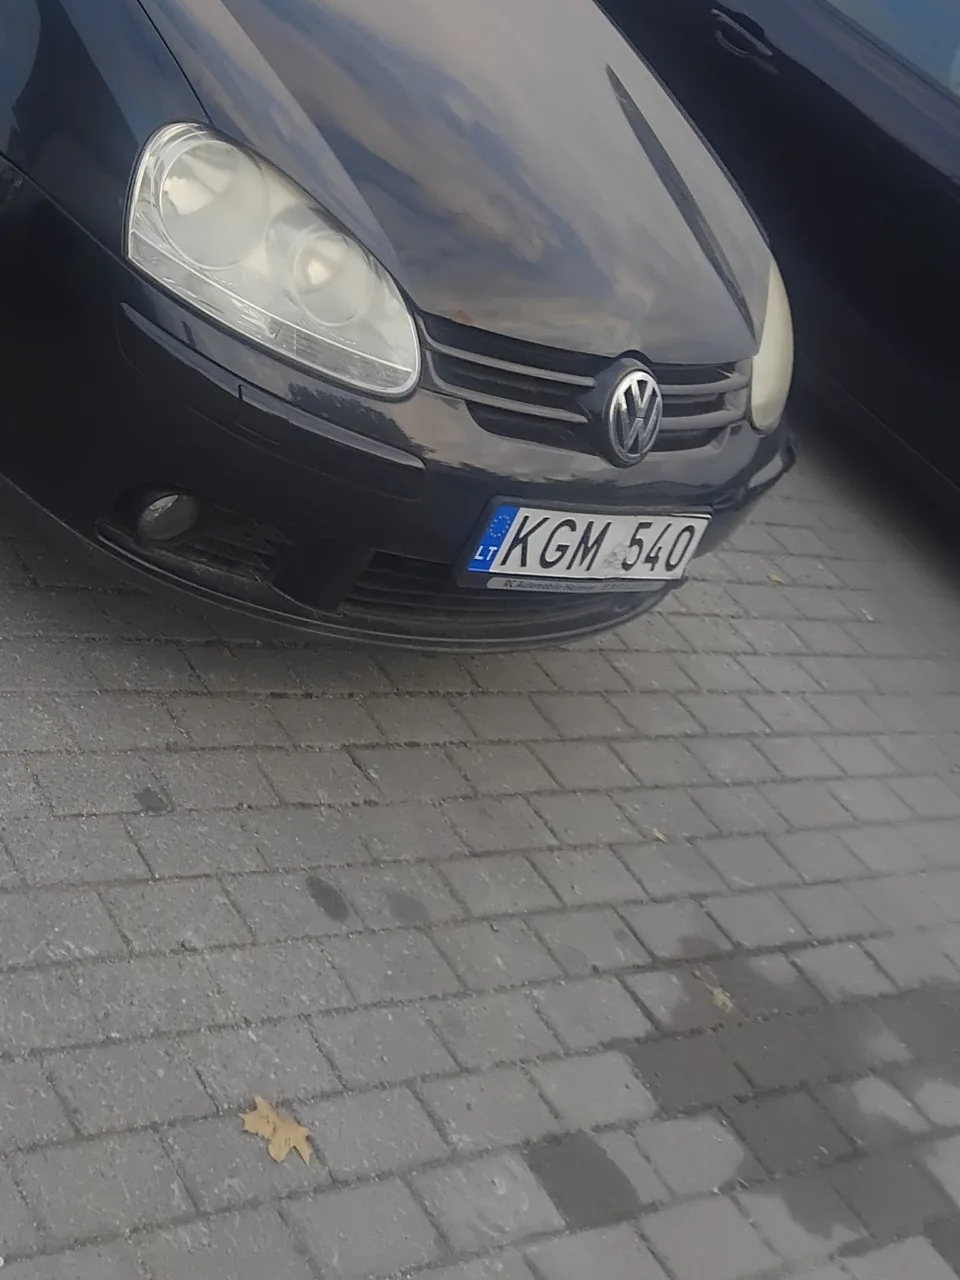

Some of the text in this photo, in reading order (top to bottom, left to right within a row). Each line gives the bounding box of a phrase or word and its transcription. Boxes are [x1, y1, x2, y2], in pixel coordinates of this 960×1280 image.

[474, 545, 499, 562] LT
[500, 515, 695, 572] KGM 540
